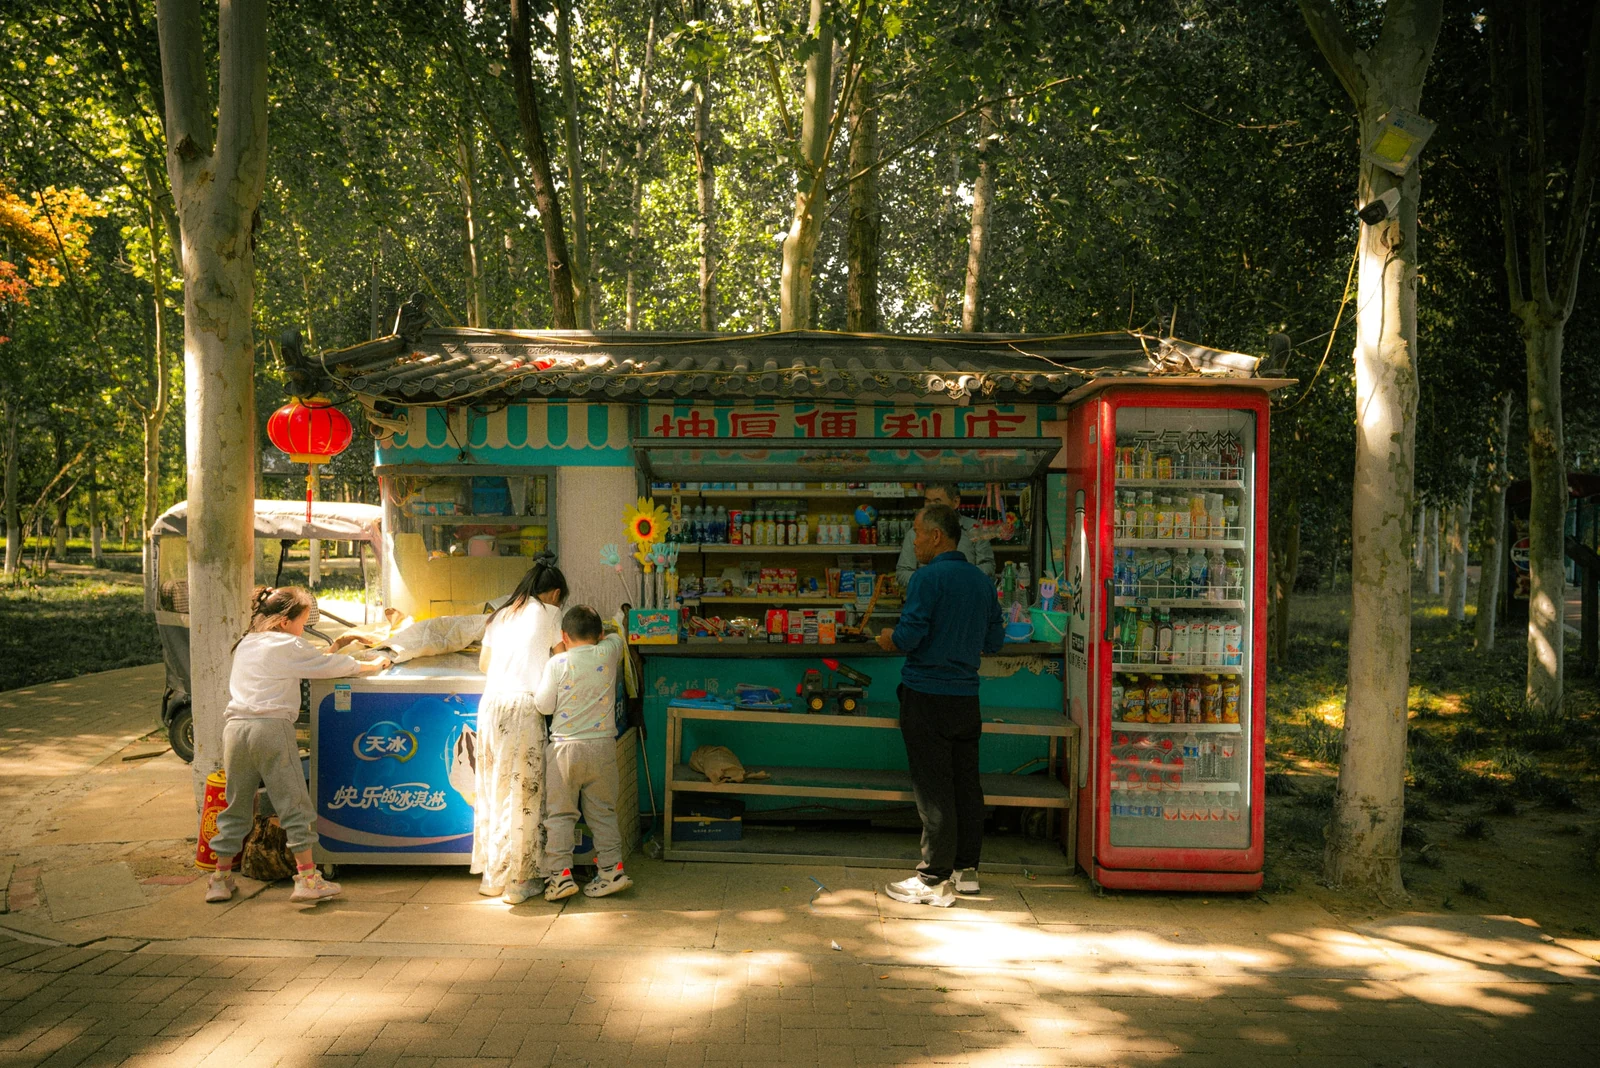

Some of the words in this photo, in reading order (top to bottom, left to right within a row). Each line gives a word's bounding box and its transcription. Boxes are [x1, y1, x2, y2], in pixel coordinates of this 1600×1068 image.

[1133, 428, 1238, 454] 元气森林
[365, 735, 407, 753] 天冰
[327, 783, 447, 812] 快乐的冰淇淋
